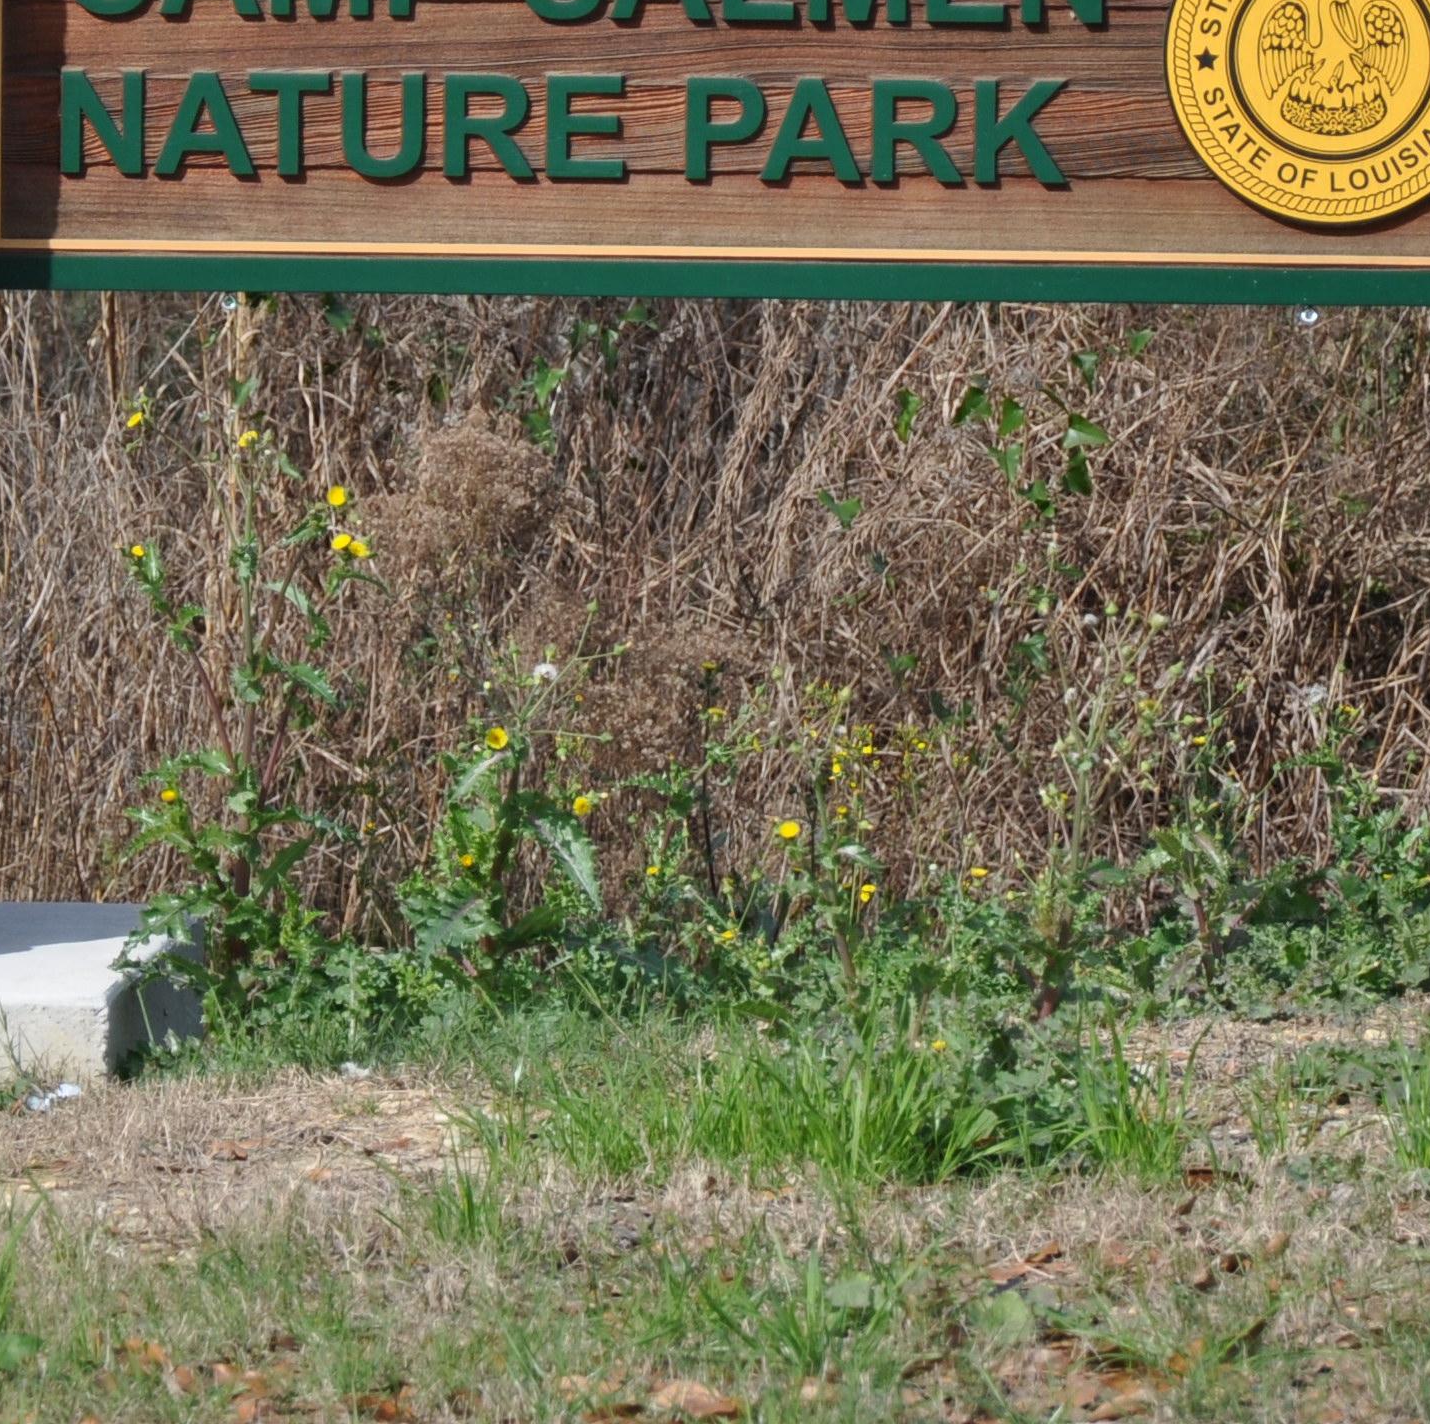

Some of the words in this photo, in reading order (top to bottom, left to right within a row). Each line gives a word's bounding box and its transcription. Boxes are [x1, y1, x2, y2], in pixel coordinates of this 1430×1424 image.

[59, 68, 627, 179] NATURE
[684, 76, 1070, 185] PARK
[1203, 86, 1272, 169] STATE
[1278, 161, 1318, 189] OF
